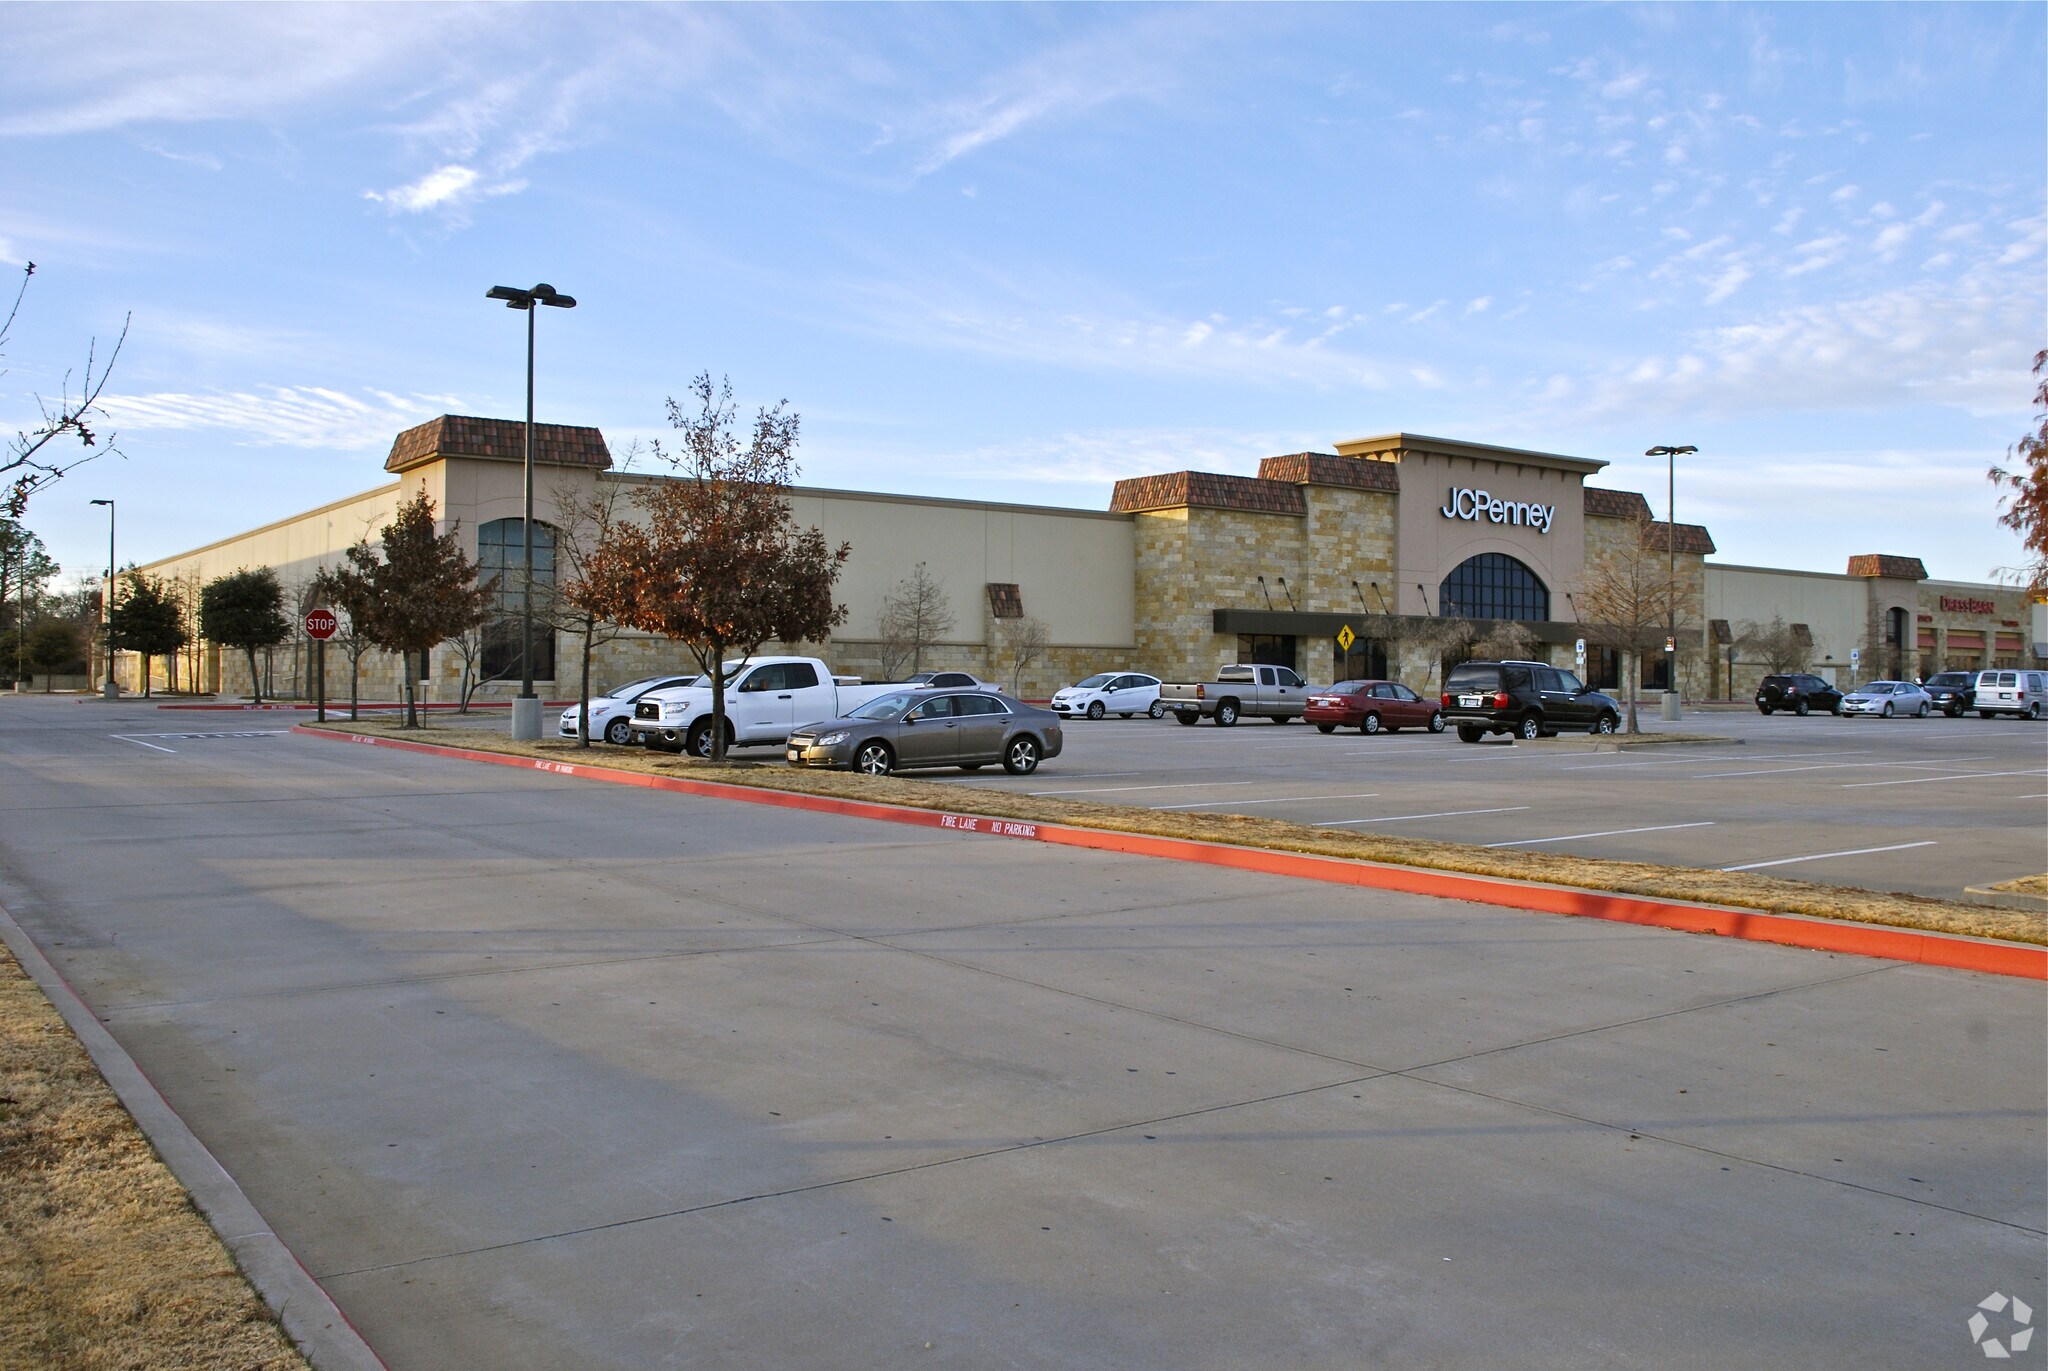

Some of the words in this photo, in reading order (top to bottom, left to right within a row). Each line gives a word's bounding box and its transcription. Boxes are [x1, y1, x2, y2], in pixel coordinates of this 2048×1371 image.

[1440, 486, 1555, 534] JCPenney
[307, 618, 335, 630] STOP
[941, 815, 956, 827] FIRE
[959, 817, 977, 830] LANE
[991, 821, 1001, 832] NO
[1004, 823, 1035, 837] PARKING
